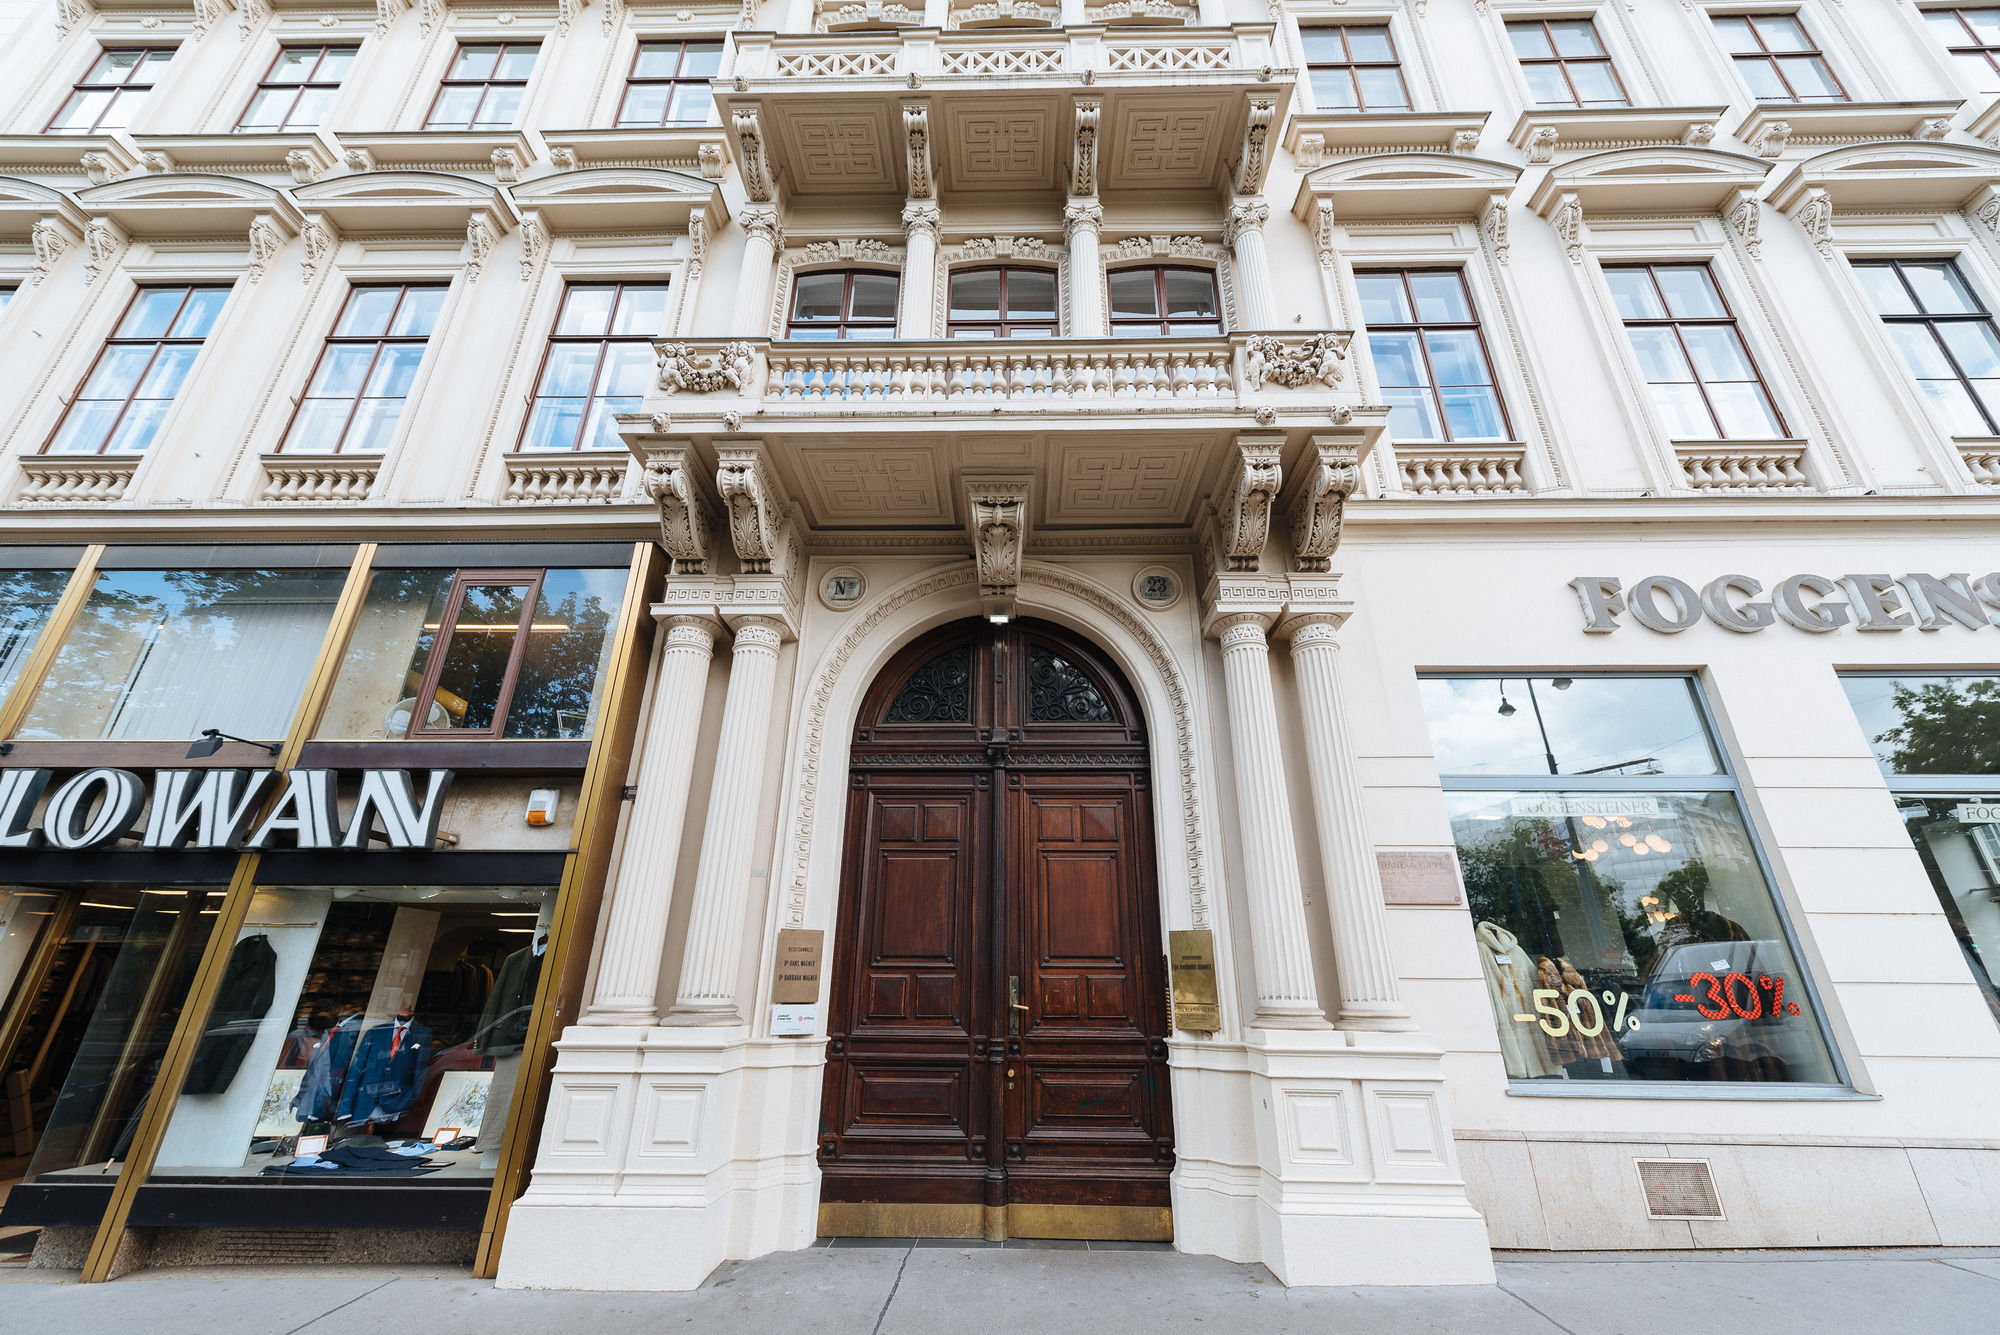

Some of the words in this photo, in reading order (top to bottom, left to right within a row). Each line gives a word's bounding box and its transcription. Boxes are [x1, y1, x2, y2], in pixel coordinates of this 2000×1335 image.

[1147, 576, 1167, 593] 23
[0, 767, 456, 850] LOWAN
[1513, 989, 1641, 1037] -50%
[1673, 971, 1801, 1021] -30%
